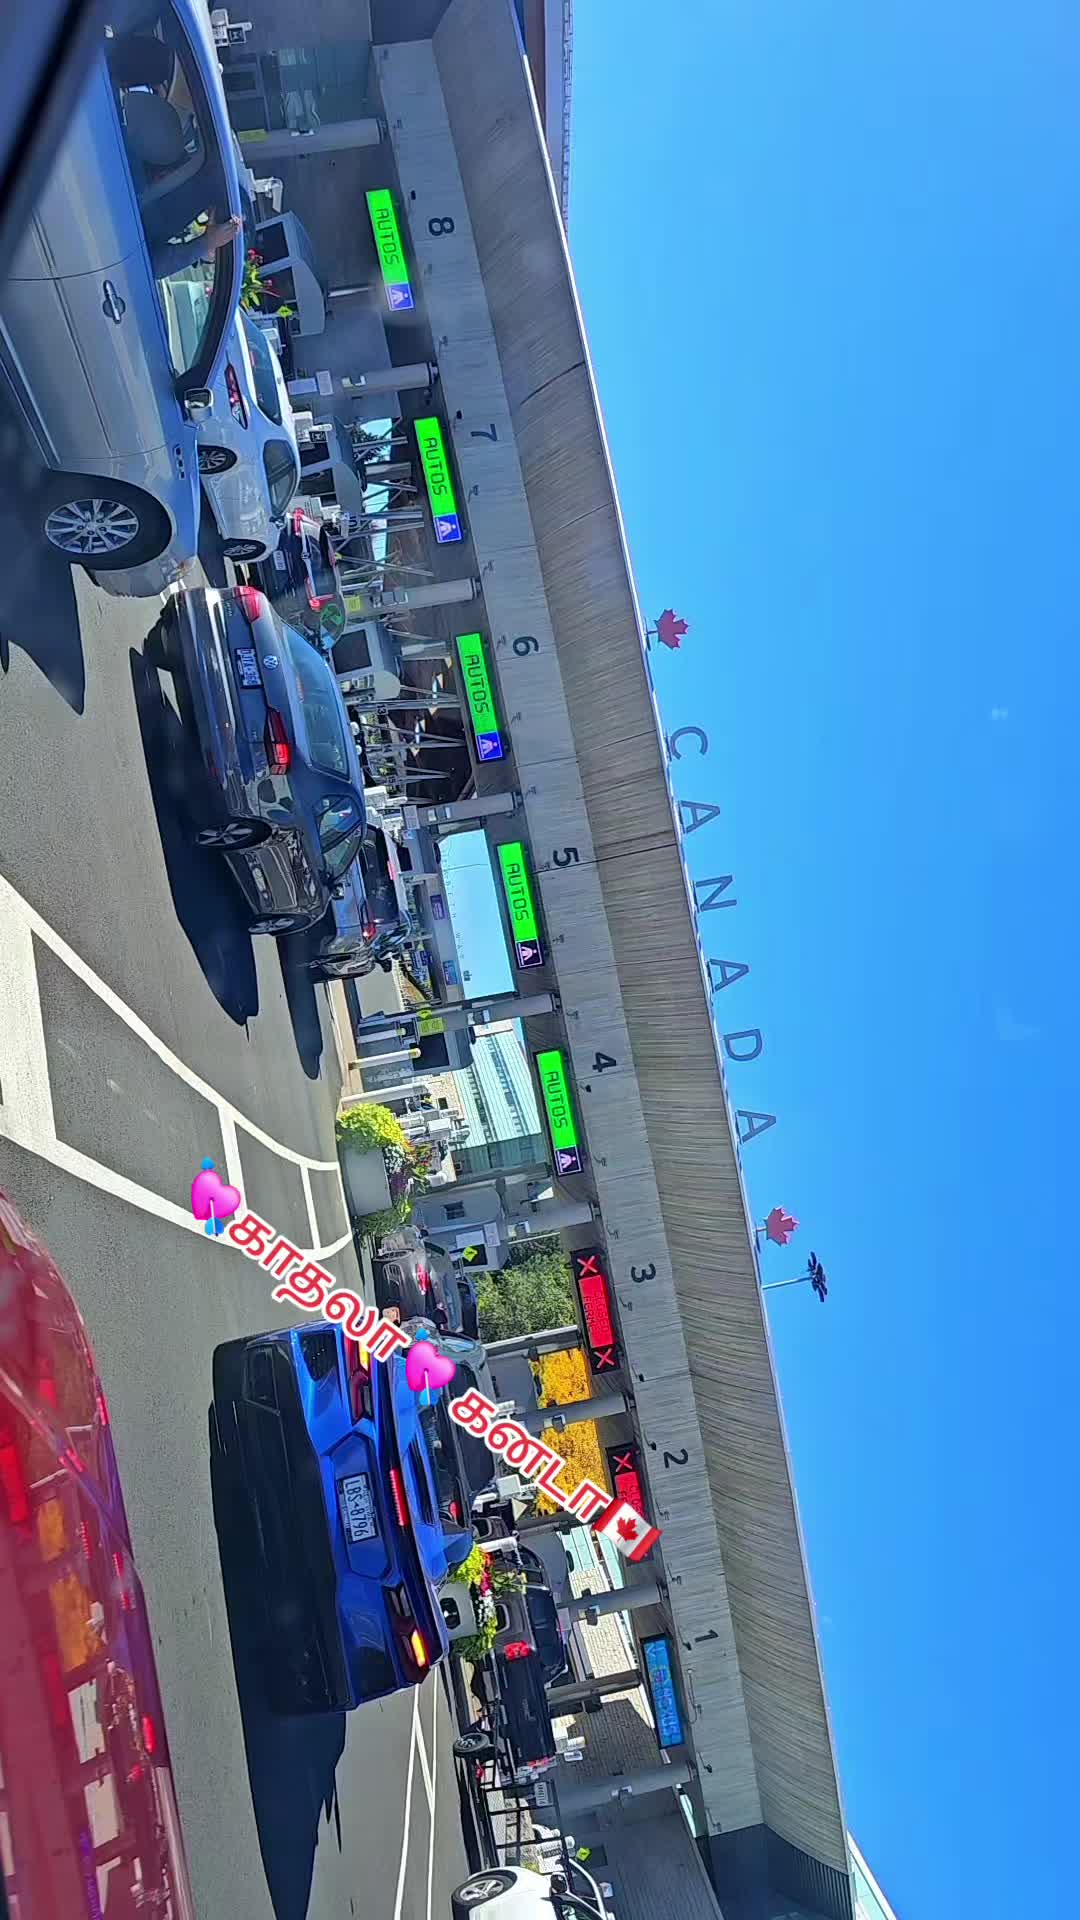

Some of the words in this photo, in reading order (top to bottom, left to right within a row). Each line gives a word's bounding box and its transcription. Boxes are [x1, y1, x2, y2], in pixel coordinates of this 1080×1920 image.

[375, 208, 399, 265] AUTOS
[428, 216, 454, 237] 8
[471, 423, 497, 442] 7
[423, 437, 448, 496] AUTOS
[512, 636, 539, 656] 6
[465, 654, 489, 714] AUTOS
[553, 847, 579, 867] 5
[505, 863, 529, 921] AUTOS
[670, 726, 777, 1143] CANADA
[592, 1052, 617, 1072] 4
[545, 1071, 568, 1129] AUTOS
[630, 1263, 656, 1283] 3
[663, 1448, 688, 1468] 2
[694, 1628, 719, 1644] 1
